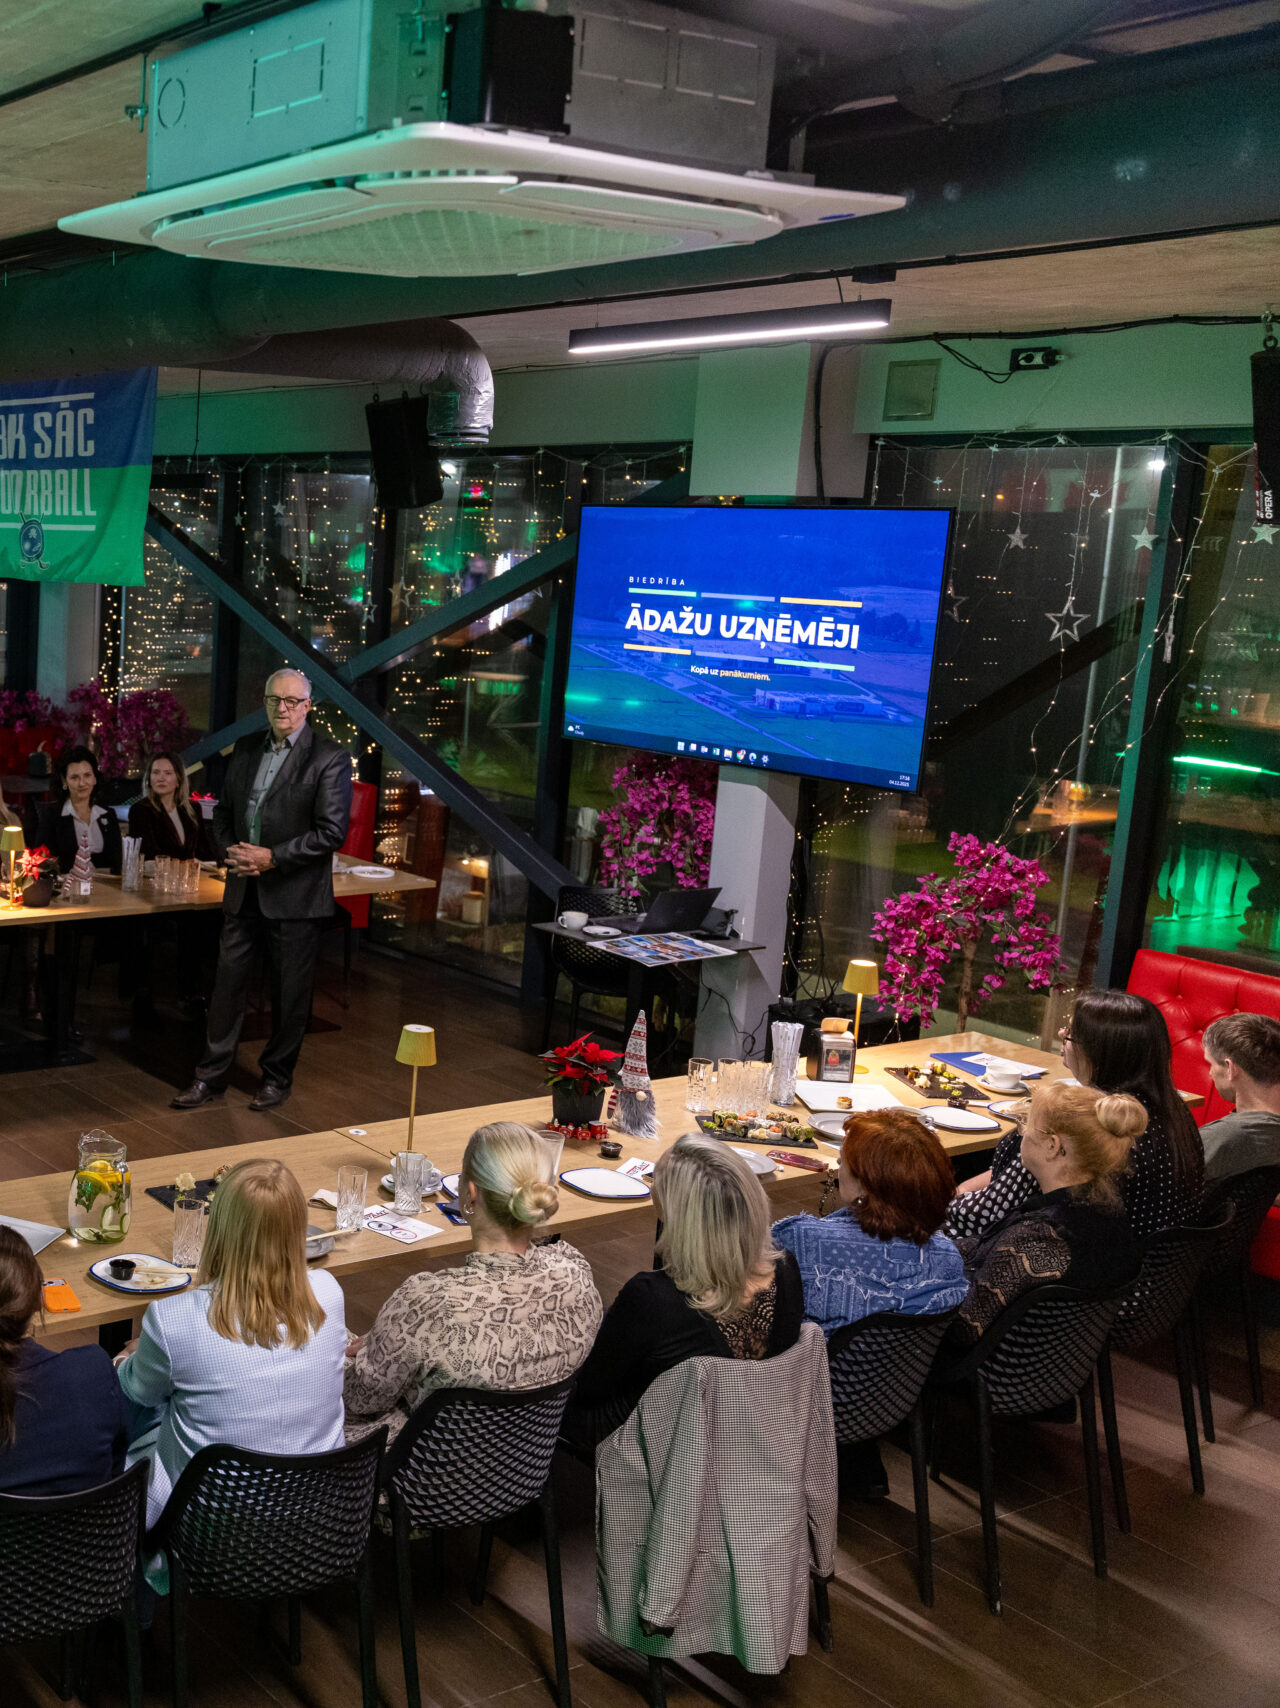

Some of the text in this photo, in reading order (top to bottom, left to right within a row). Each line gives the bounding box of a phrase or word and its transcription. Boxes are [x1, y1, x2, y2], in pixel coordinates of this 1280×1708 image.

[33, 402, 95, 459] SĀC
[1264, 490, 1273, 519] OPERA
[628, 576, 686, 586] BIEDRĪBA
[625, 602, 860, 649] ĀDAŽU UZŅĒMĒJI
[690, 665, 709, 675] Kopā
[719, 669, 771, 682] panākumiem.
